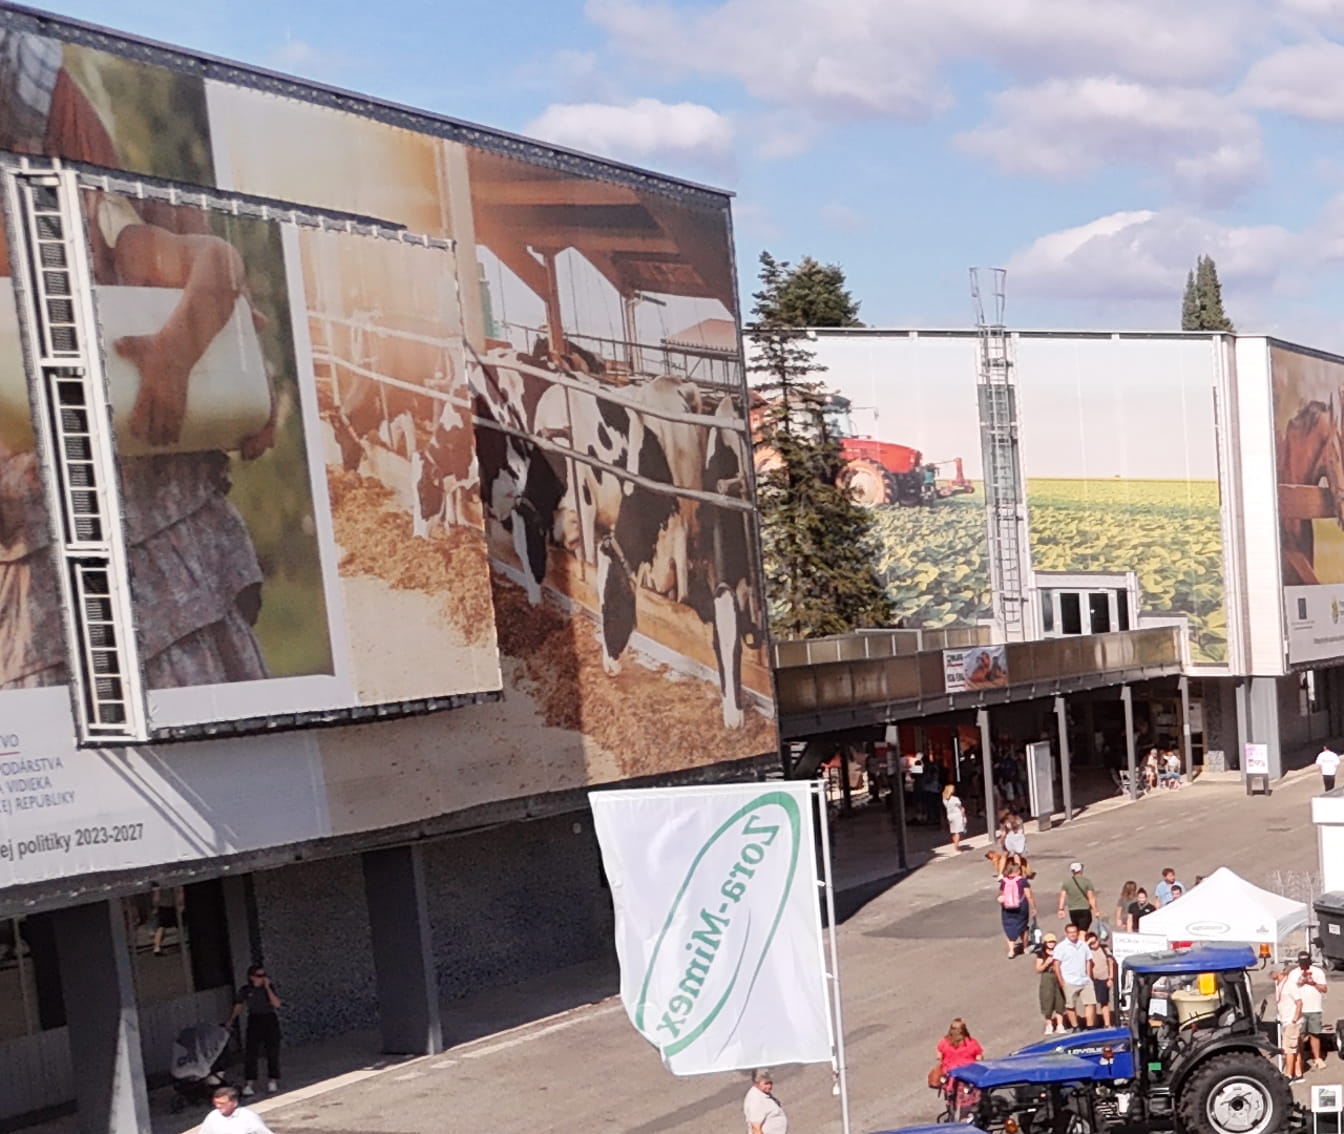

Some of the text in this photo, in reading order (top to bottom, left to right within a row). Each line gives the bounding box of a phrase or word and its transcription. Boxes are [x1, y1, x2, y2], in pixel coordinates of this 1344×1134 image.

[16, 790, 76, 810] REPUBLIKY
[18, 832, 71, 860] politiky
[75, 822, 143, 847] 2023-2027
